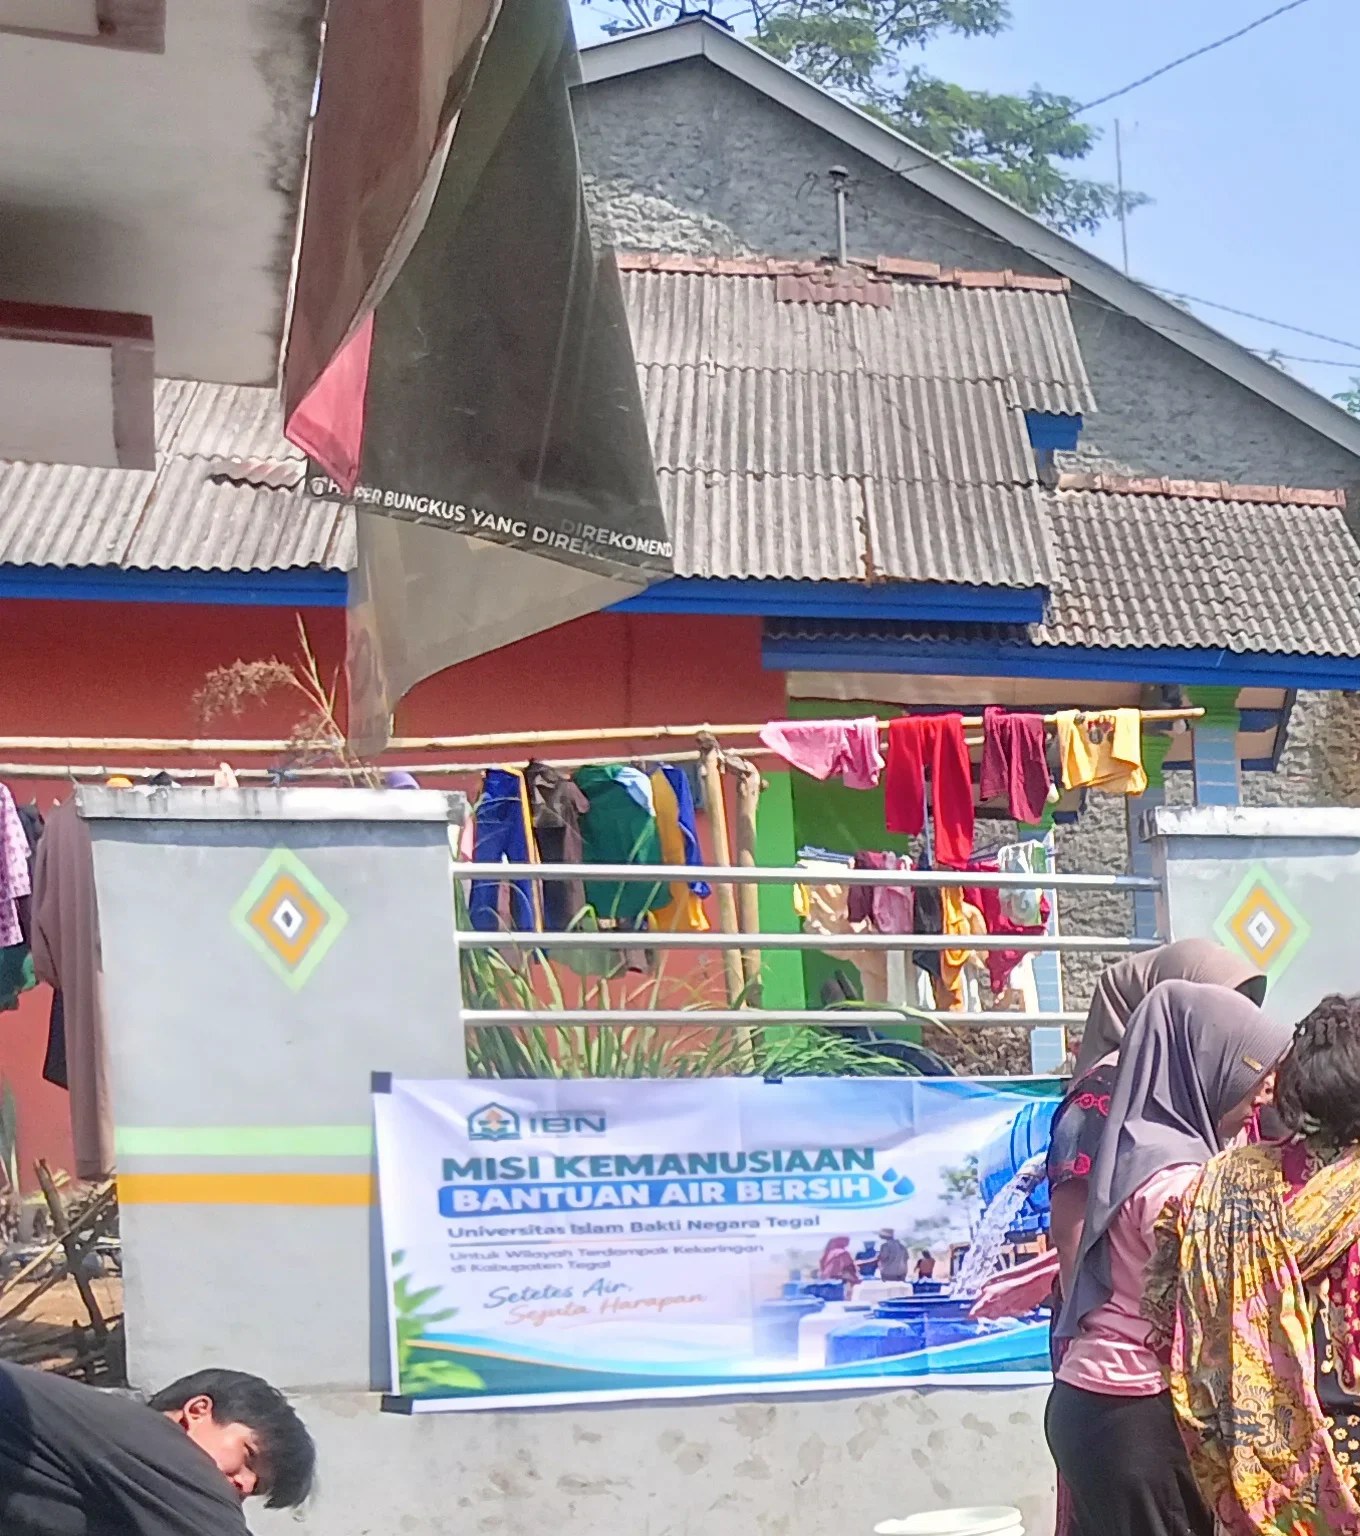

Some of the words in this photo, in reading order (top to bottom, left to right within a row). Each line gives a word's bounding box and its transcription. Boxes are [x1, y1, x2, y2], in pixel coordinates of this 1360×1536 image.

[384, 490, 466, 522] BUNGKUS
[471, 508, 527, 538] YANG
[529, 1117, 607, 1134] IBN
[442, 1156, 540, 1181] MISI
[554, 1147, 875, 1179] KEMANUSIAAN
[452, 1183, 650, 1212] BANTUAN
[659, 1181, 726, 1205] AIR
[736, 1177, 870, 1203] BERSIH
[448, 1224, 566, 1239] Universitas
[570, 1221, 624, 1235] Islam
[630, 1219, 682, 1233] Bakti
[687, 1219, 760, 1233] Negara
[765, 1215, 820, 1229] Tegal
[450, 1251, 500, 1260] Untuk
[505, 1249, 573, 1260] Wilayah
[577, 1247, 669, 1257] Terdampak
[673, 1245, 764, 1255] Kekeringan
[451, 1263, 466, 1273] di
[471, 1263, 563, 1273] Kabupaten
[568, 1260, 611, 1271] Tegal
[483, 1283, 574, 1309] Setetes
[600, 1294, 708, 1315] Harapan
